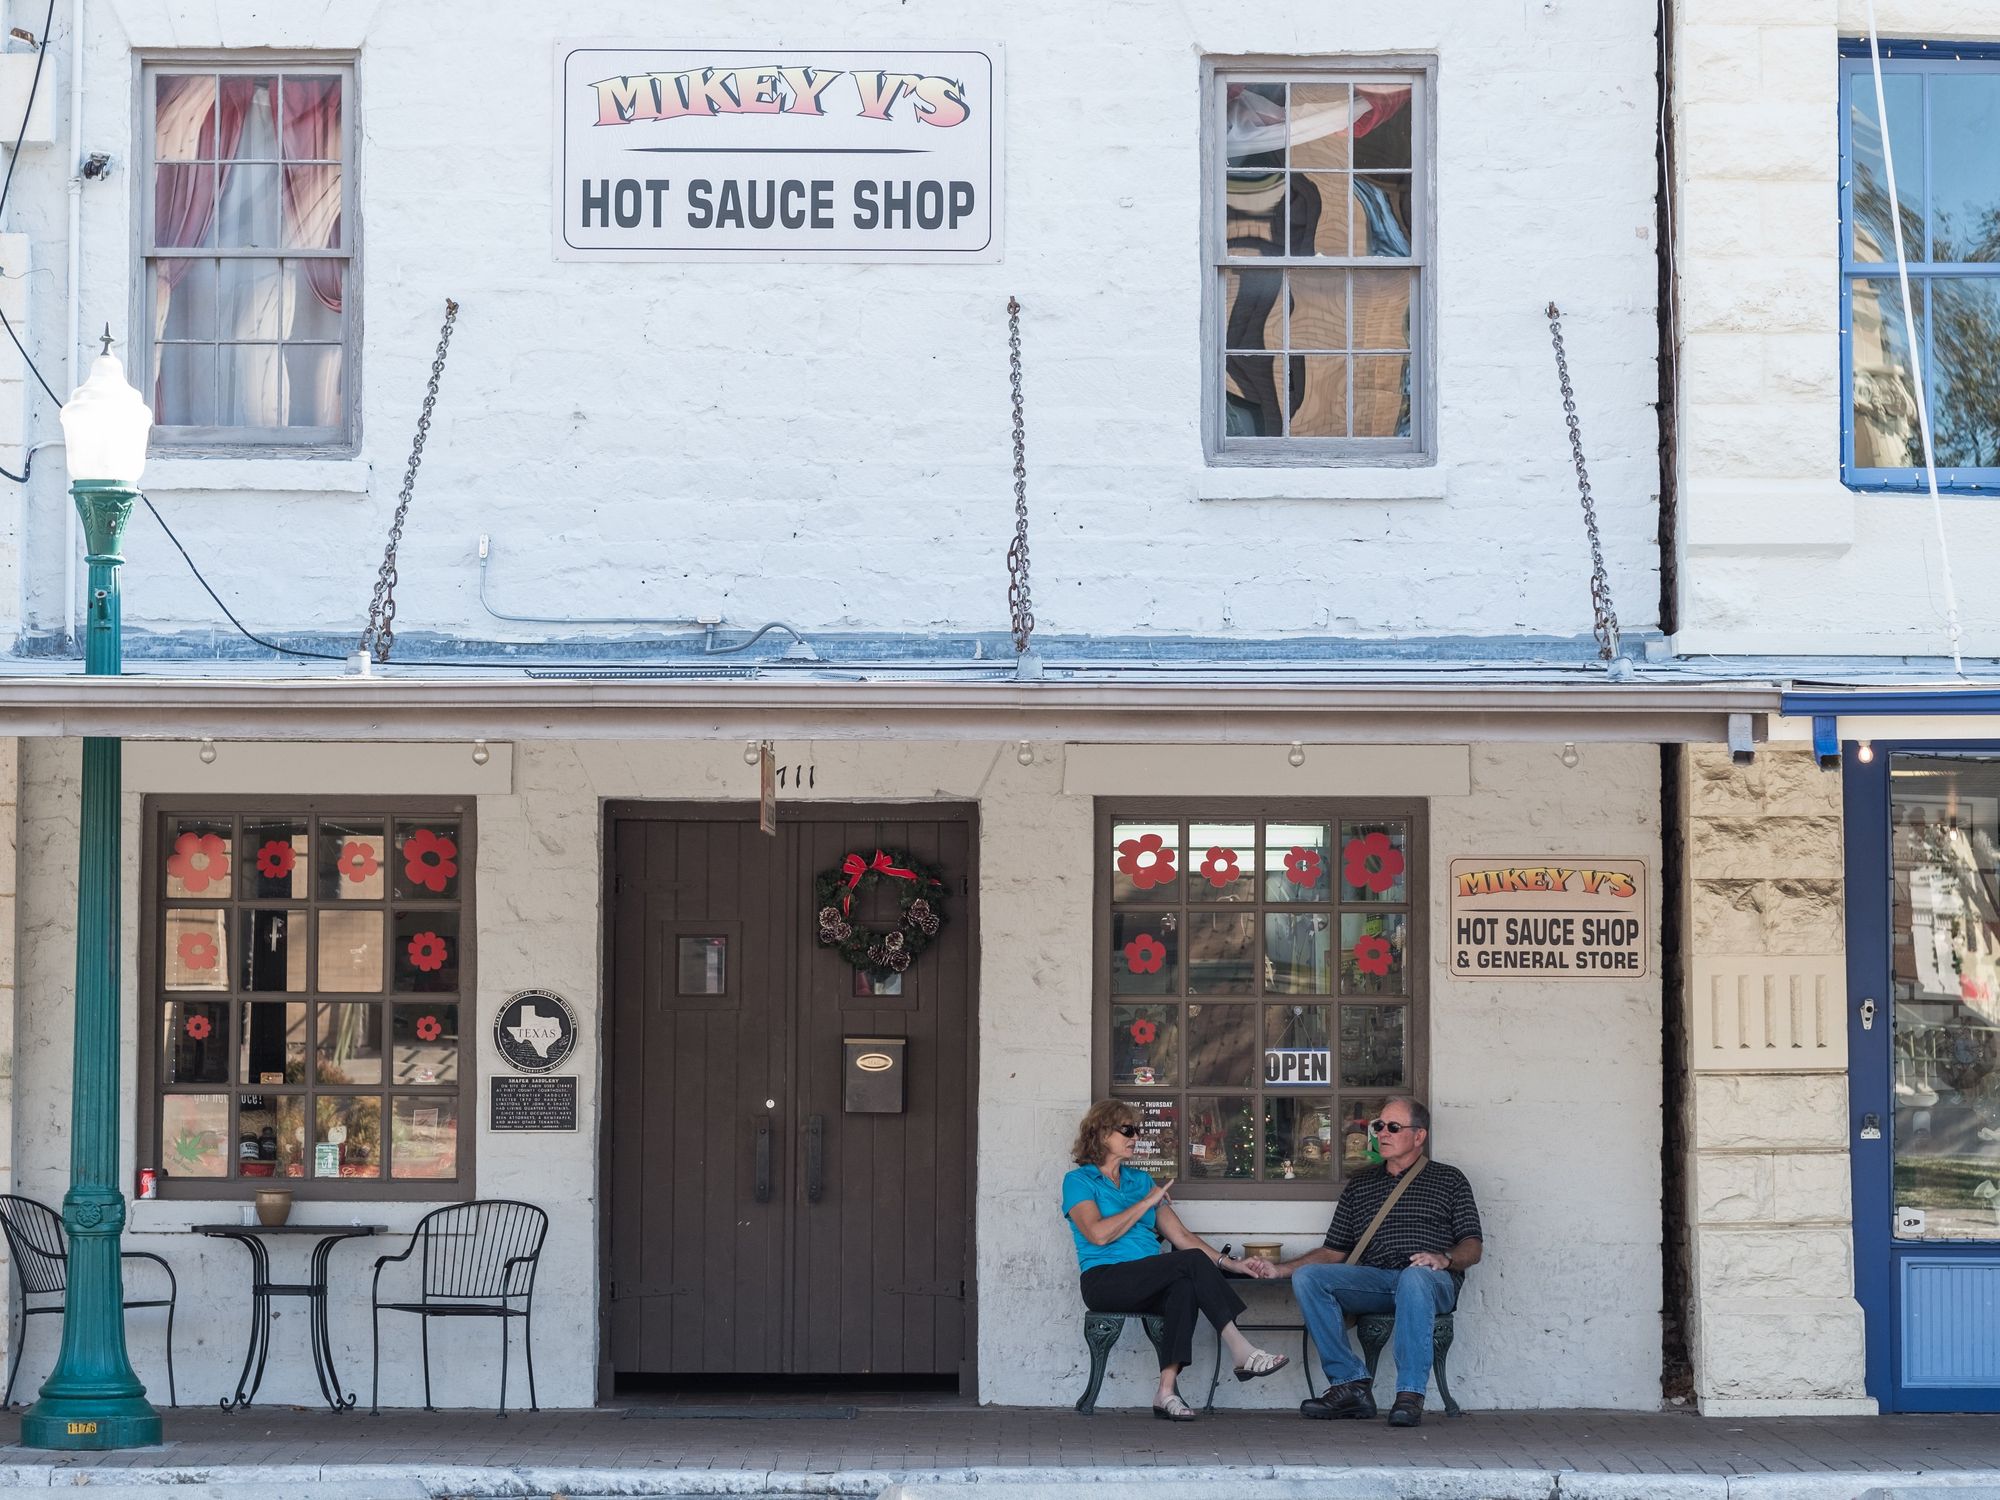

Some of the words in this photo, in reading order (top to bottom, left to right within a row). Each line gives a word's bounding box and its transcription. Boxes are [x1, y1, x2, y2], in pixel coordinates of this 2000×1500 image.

[587, 66, 844, 127] MIKEY
[850, 70, 970, 128] V'S
[582, 179, 670, 228] HOT
[688, 180, 834, 229] SAUCE
[853, 180, 974, 230] SHOP
[1456, 867, 1577, 897] MIKEY
[1580, 870, 1636, 898] V'S
[1458, 918, 1498, 945] HOT
[1506, 918, 1574, 946] SAUCE
[1582, 919, 1639, 946] SHOP
[1456, 950, 1470, 968] &
[1477, 951, 1569, 968] GENERAL
[1576, 951, 1639, 969] STORE
[517, 1029, 556, 1038] TEXAS
[1265, 1053, 1327, 1081] OPEN
[68, 1423, 95, 1433] 1176
